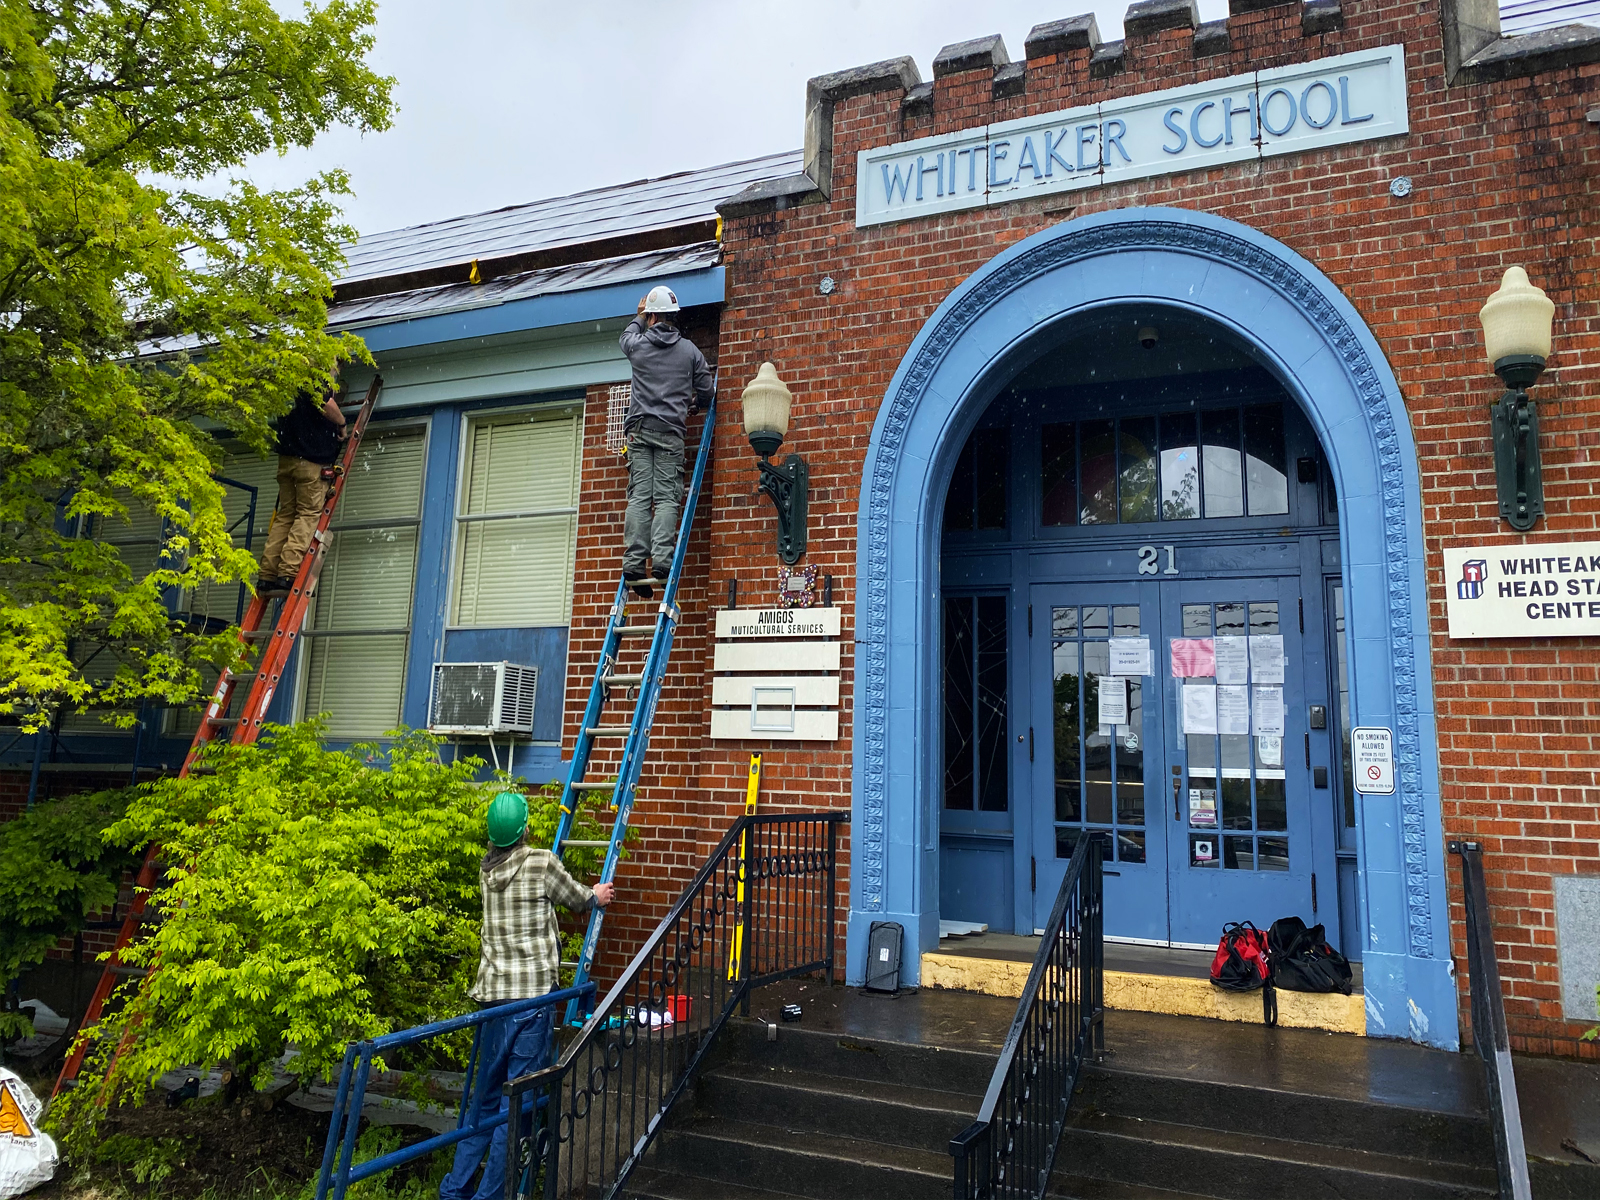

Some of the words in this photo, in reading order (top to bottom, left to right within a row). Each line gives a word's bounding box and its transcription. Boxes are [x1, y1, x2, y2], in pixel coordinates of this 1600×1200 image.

[880, 119, 1131, 204] WHITEAKER
[1162, 76, 1374, 153] SCHOOL
[1138, 545, 1179, 574] 21
[1500, 556, 1600, 575] WHITEAK
[1498, 580, 1559, 597] HEAD
[1566, 579, 1600, 595] ST
[758, 611, 794, 624] AMIGOS
[1526, 602, 1600, 619] CENTE
[731, 625, 784, 635] MUTICULTURAL
